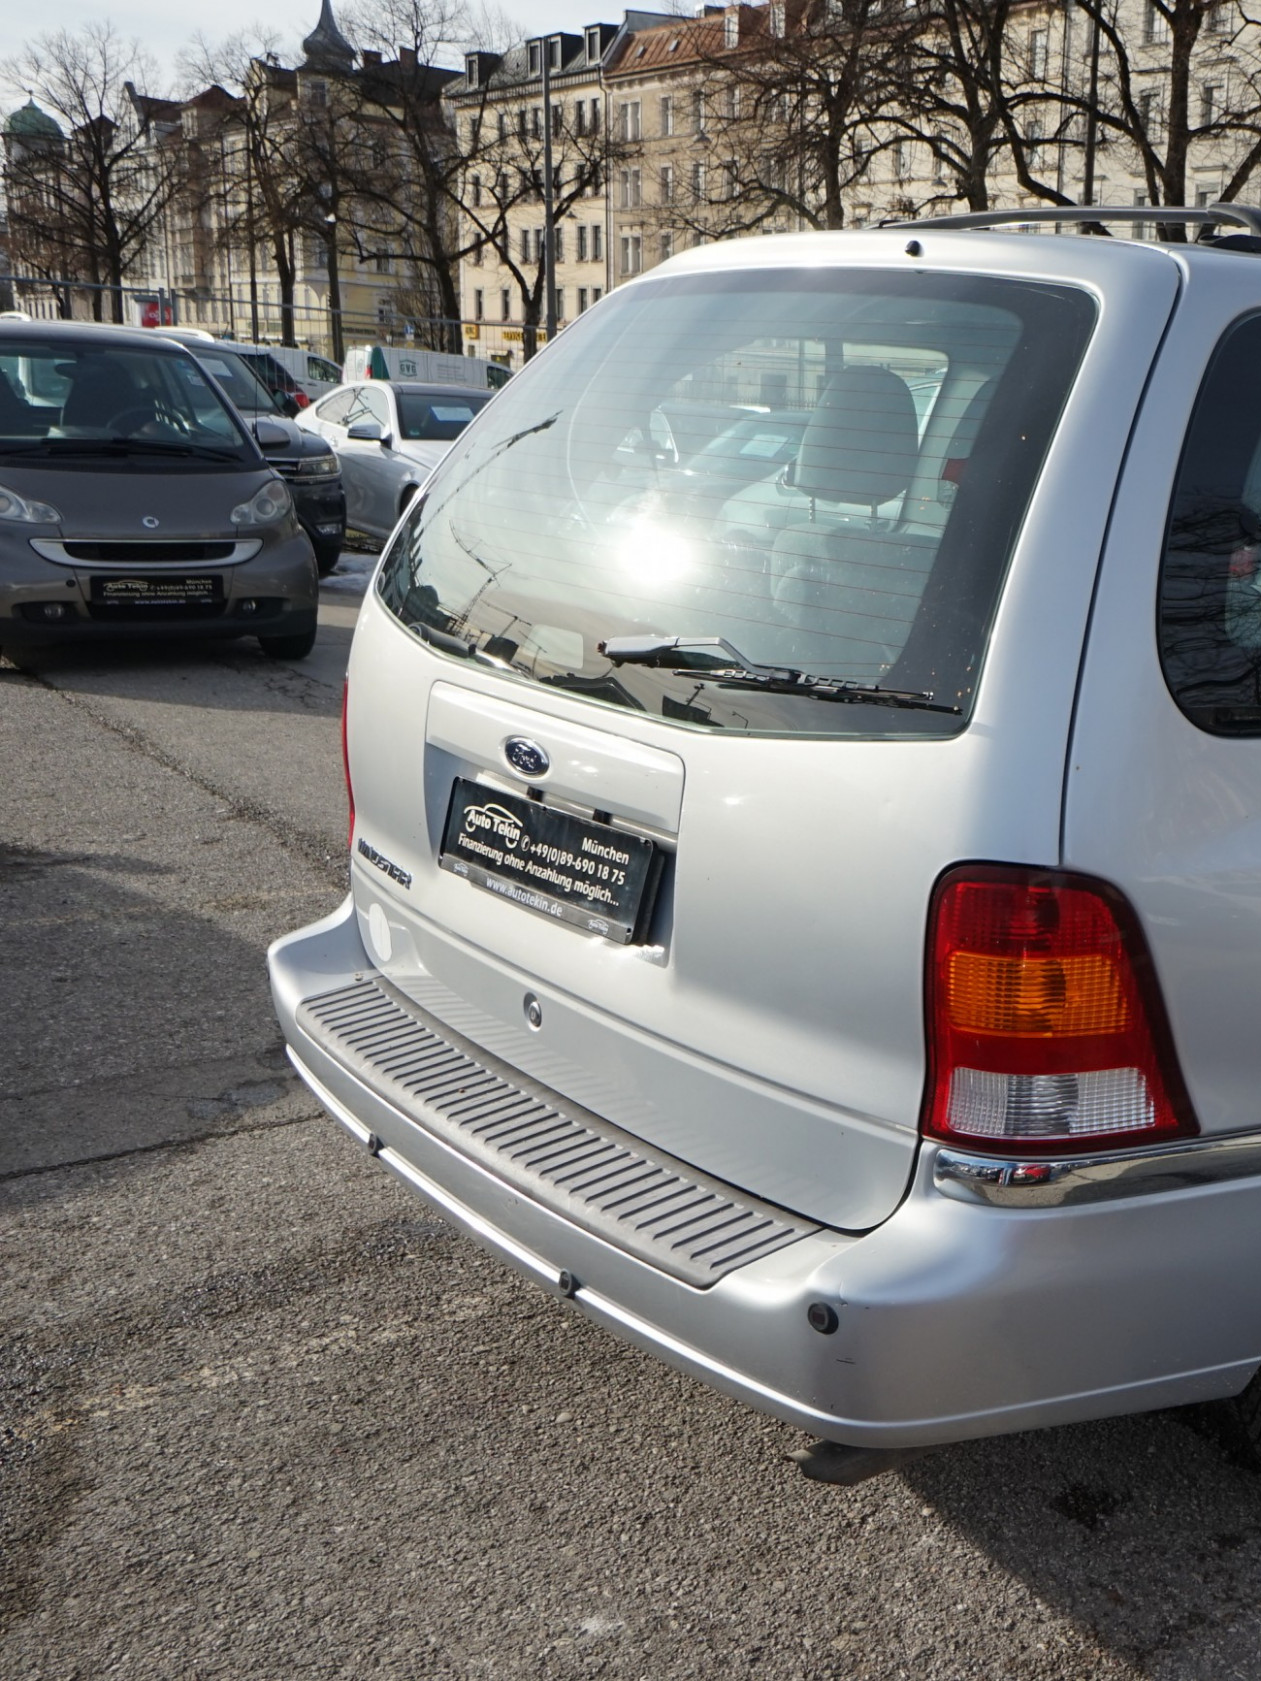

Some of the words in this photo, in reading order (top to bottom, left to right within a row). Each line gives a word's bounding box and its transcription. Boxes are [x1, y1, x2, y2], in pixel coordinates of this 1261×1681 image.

[467, 810, 491, 829] Auto
[491, 818, 521, 841] Tekin
[457, 832, 504, 866] Finanzierung
[504, 853, 526, 871] ohne
[525, 861, 573, 893] Anzahlung
[573, 881, 620, 907] möglich...
[530, 843, 596, 876] +49(0)89-690
[597, 864, 610, 880] 18
[611, 869, 626, 886] 75
[581, 837, 630, 866] München
[486, 877, 563, 917] www.autotekin.de
